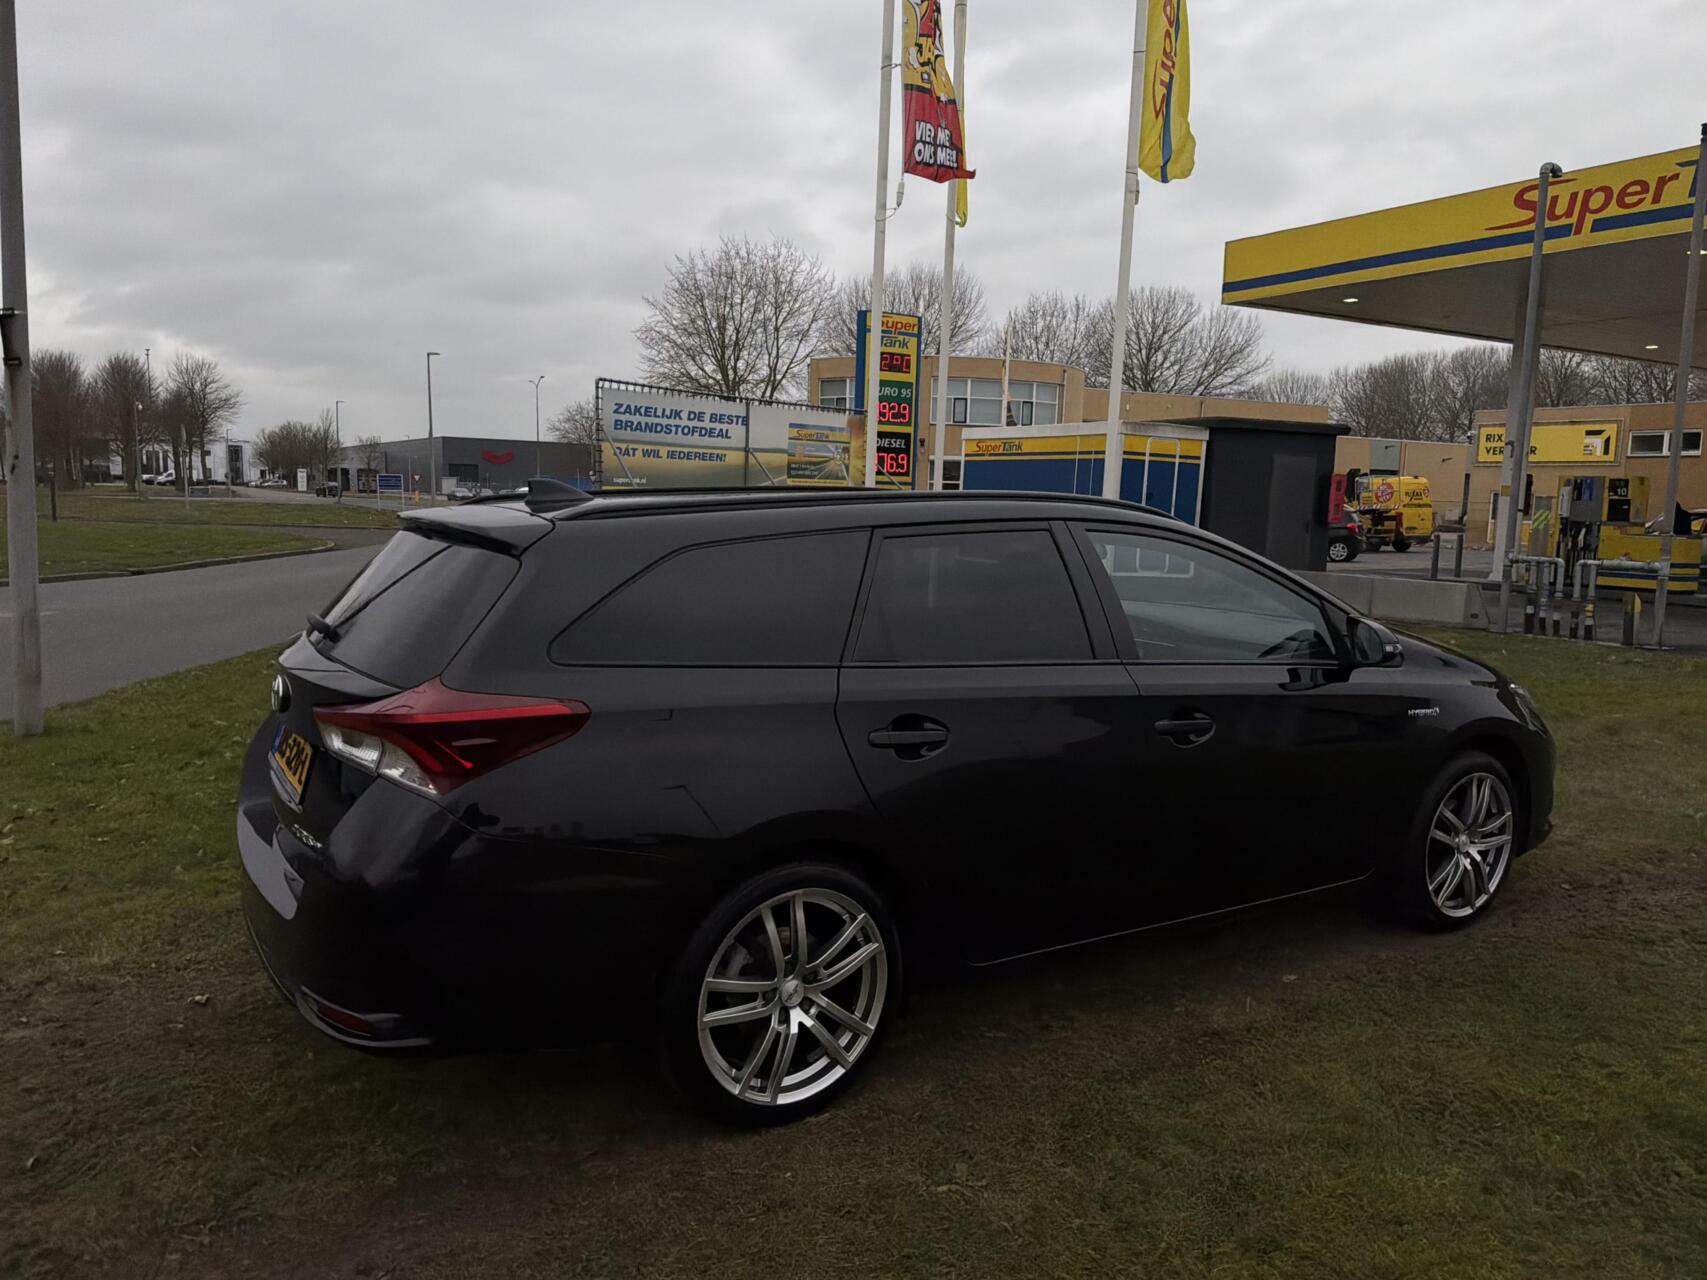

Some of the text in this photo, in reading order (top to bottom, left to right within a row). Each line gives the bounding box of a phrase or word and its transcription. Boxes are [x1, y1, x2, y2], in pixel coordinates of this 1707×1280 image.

[913, 142, 935, 165] ONS
[878, 386, 912, 399] URO 95
[612, 402, 748, 427] ZAKELIJK DE BESTE
[612, 418, 732, 440] BRANDSTOFDEAL
[641, 448, 663, 460] WIL
[666, 449, 727, 463] IEDEREEN!
[974, 440, 1024, 455] SuperTank
